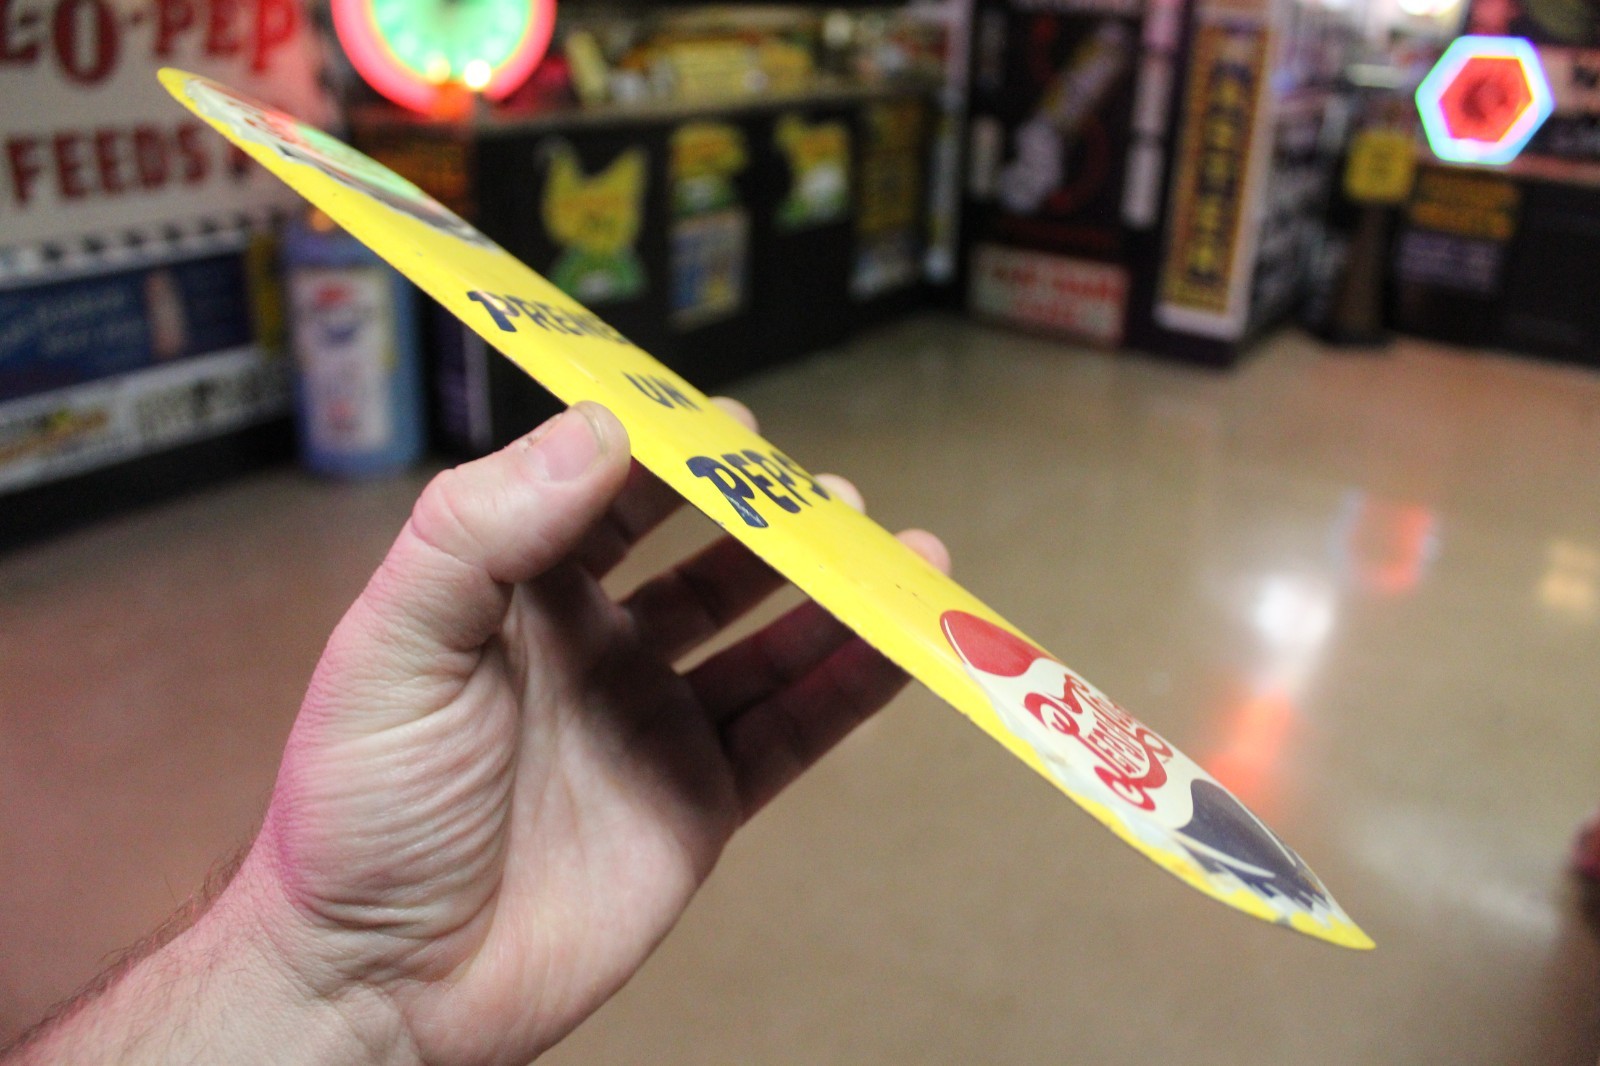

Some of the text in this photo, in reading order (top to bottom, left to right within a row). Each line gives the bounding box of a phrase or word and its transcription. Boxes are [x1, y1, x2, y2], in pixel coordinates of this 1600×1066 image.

[6, 121, 212, 211] FEEDS
[620, 369, 704, 413] UN
[686, 449, 832, 529] PEPS
